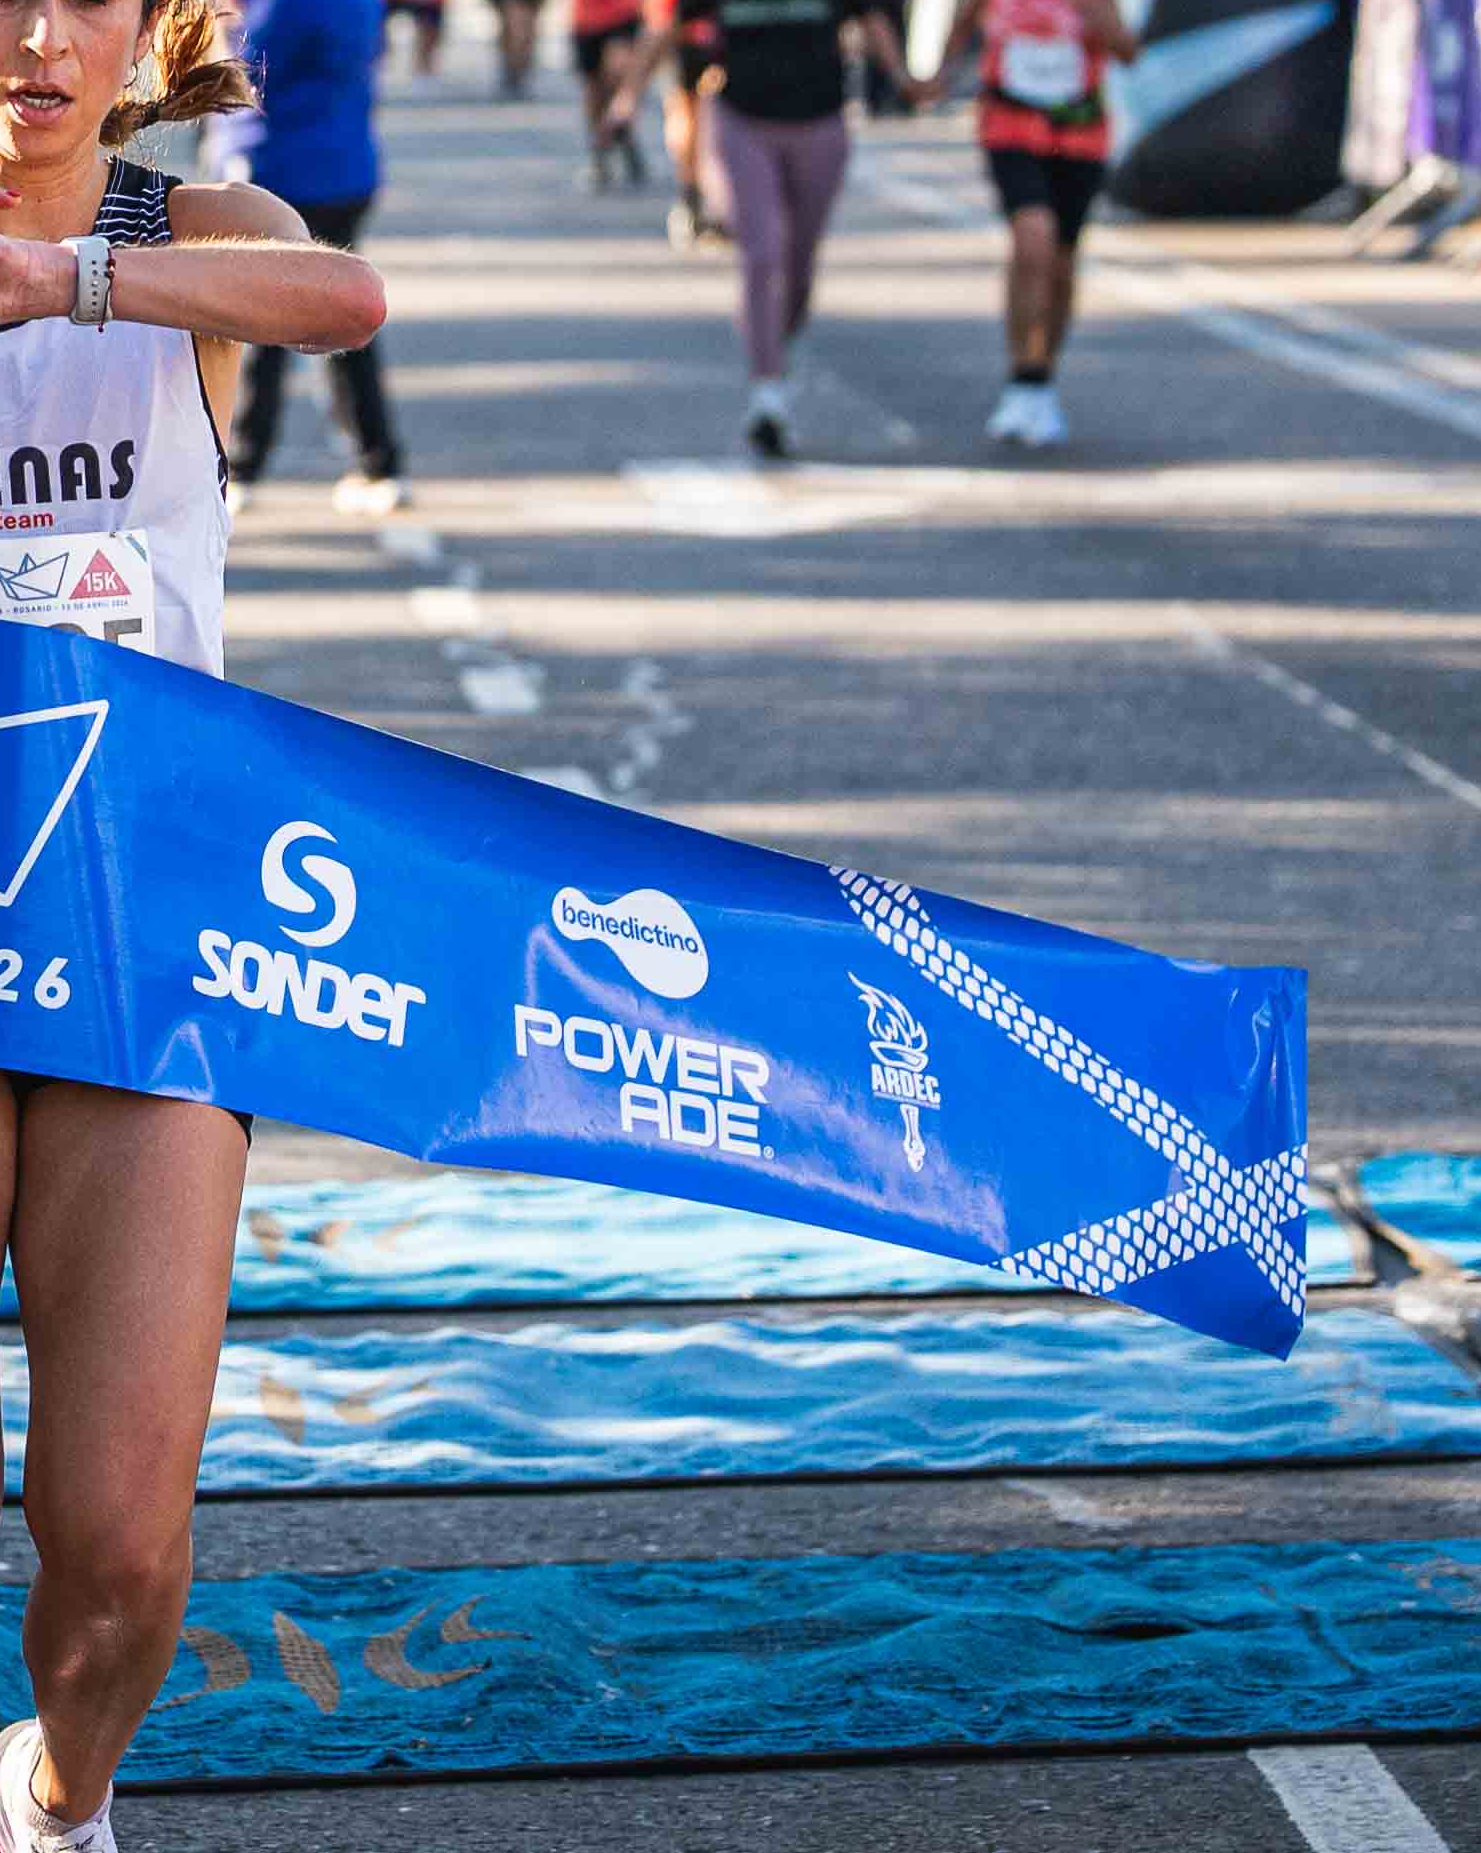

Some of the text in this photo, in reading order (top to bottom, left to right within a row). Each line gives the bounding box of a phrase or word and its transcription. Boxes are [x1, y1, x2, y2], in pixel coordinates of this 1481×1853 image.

[83, 571, 119, 593] 15K
[13, 604, 52, 614] ROSARIO
[561, 899, 699, 954] benedictino
[514, 1003, 770, 1104] POWER
[871, 1062, 941, 1105] ARDEC
